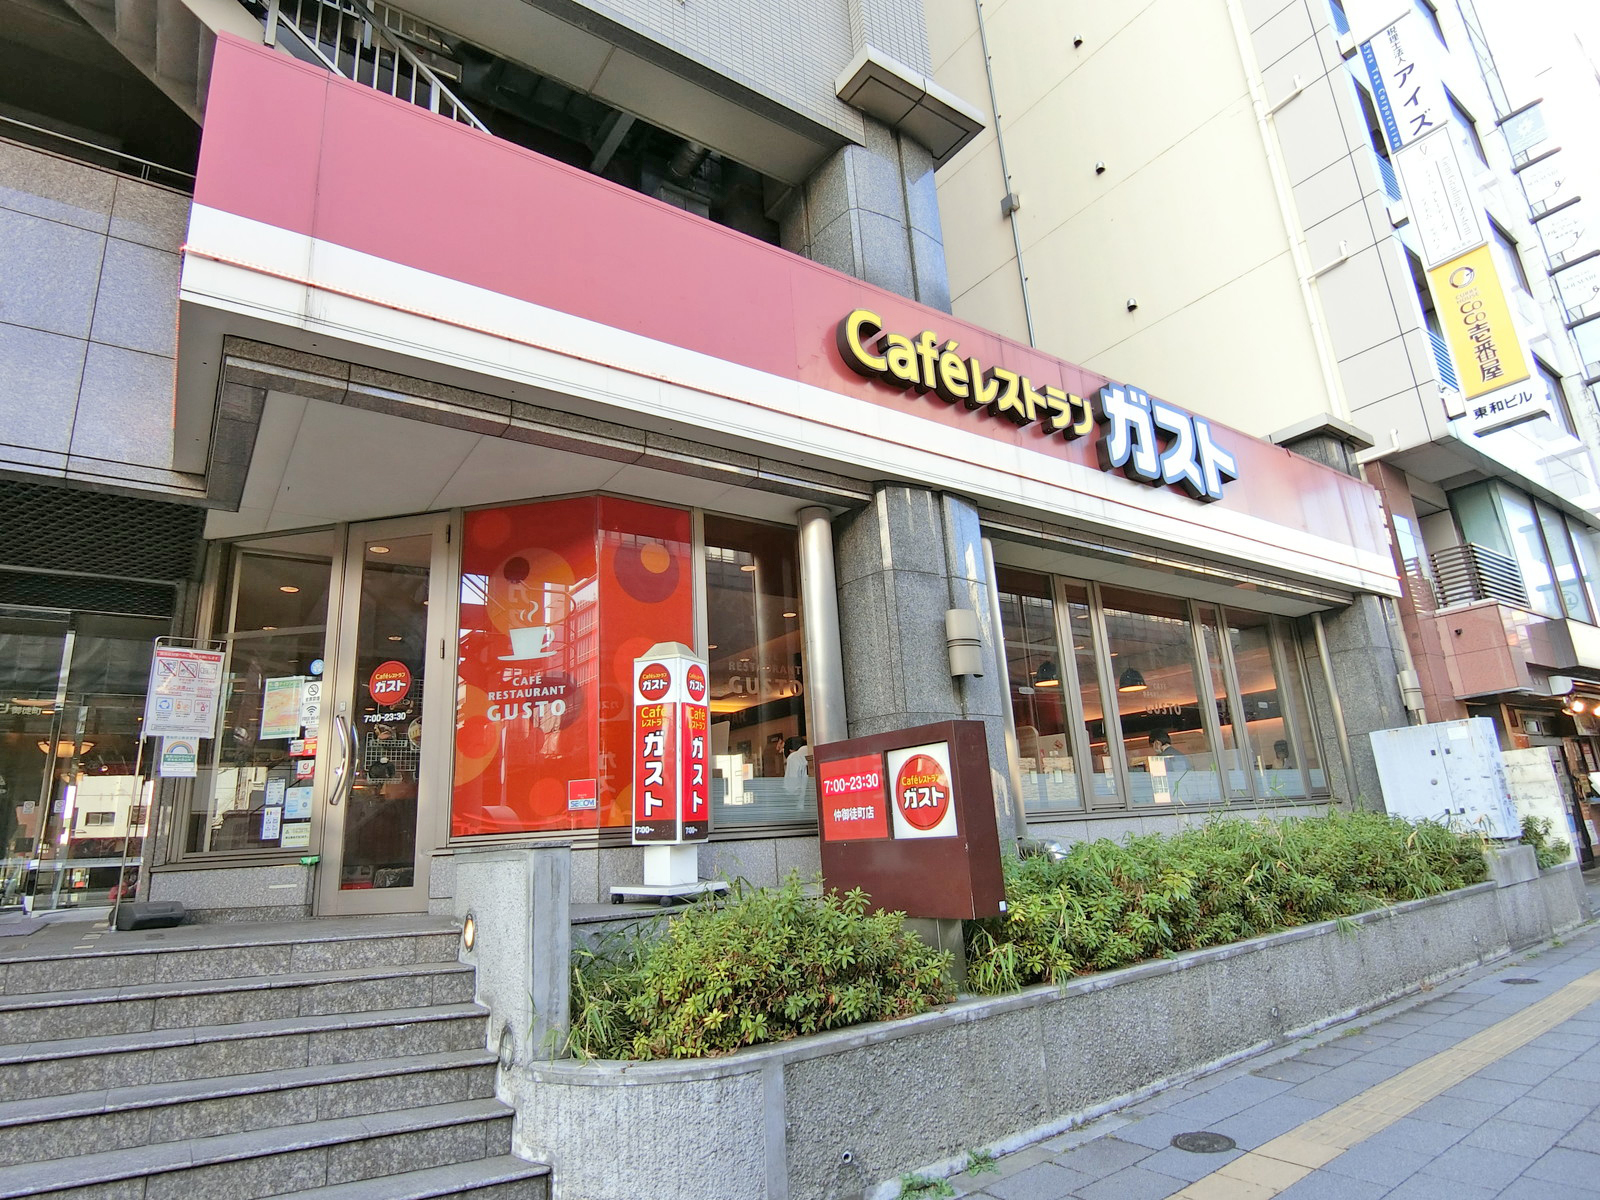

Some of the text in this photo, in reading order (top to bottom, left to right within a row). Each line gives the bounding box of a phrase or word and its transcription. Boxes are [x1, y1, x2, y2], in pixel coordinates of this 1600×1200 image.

[1363, 42, 1401, 149] Eyes Tax Corporation
[1393, 62, 1433, 137] アイズ
[842, 308, 1094, 436] Caféレストラン
[1473, 391, 1533, 420] 東和ビル
[1098, 382, 1239, 500] ガスト
[374, 679, 407, 694] ガスト
[512, 671, 542, 687] CAFÉ
[642, 679, 668, 691] ガスト
[689, 679, 704, 692] ガスト
[728, 675, 803, 697] GUSTO
[488, 685, 566, 701] RESTAURANT
[487, 699, 566, 722] GUSTO
[642, 730, 664, 817] ガスト
[691, 736, 703, 813] ガスト
[570, 799, 595, 808] SECOM
[903, 786, 945, 810] ガスト
[833, 806, 875, 822] 仲御徒町店
